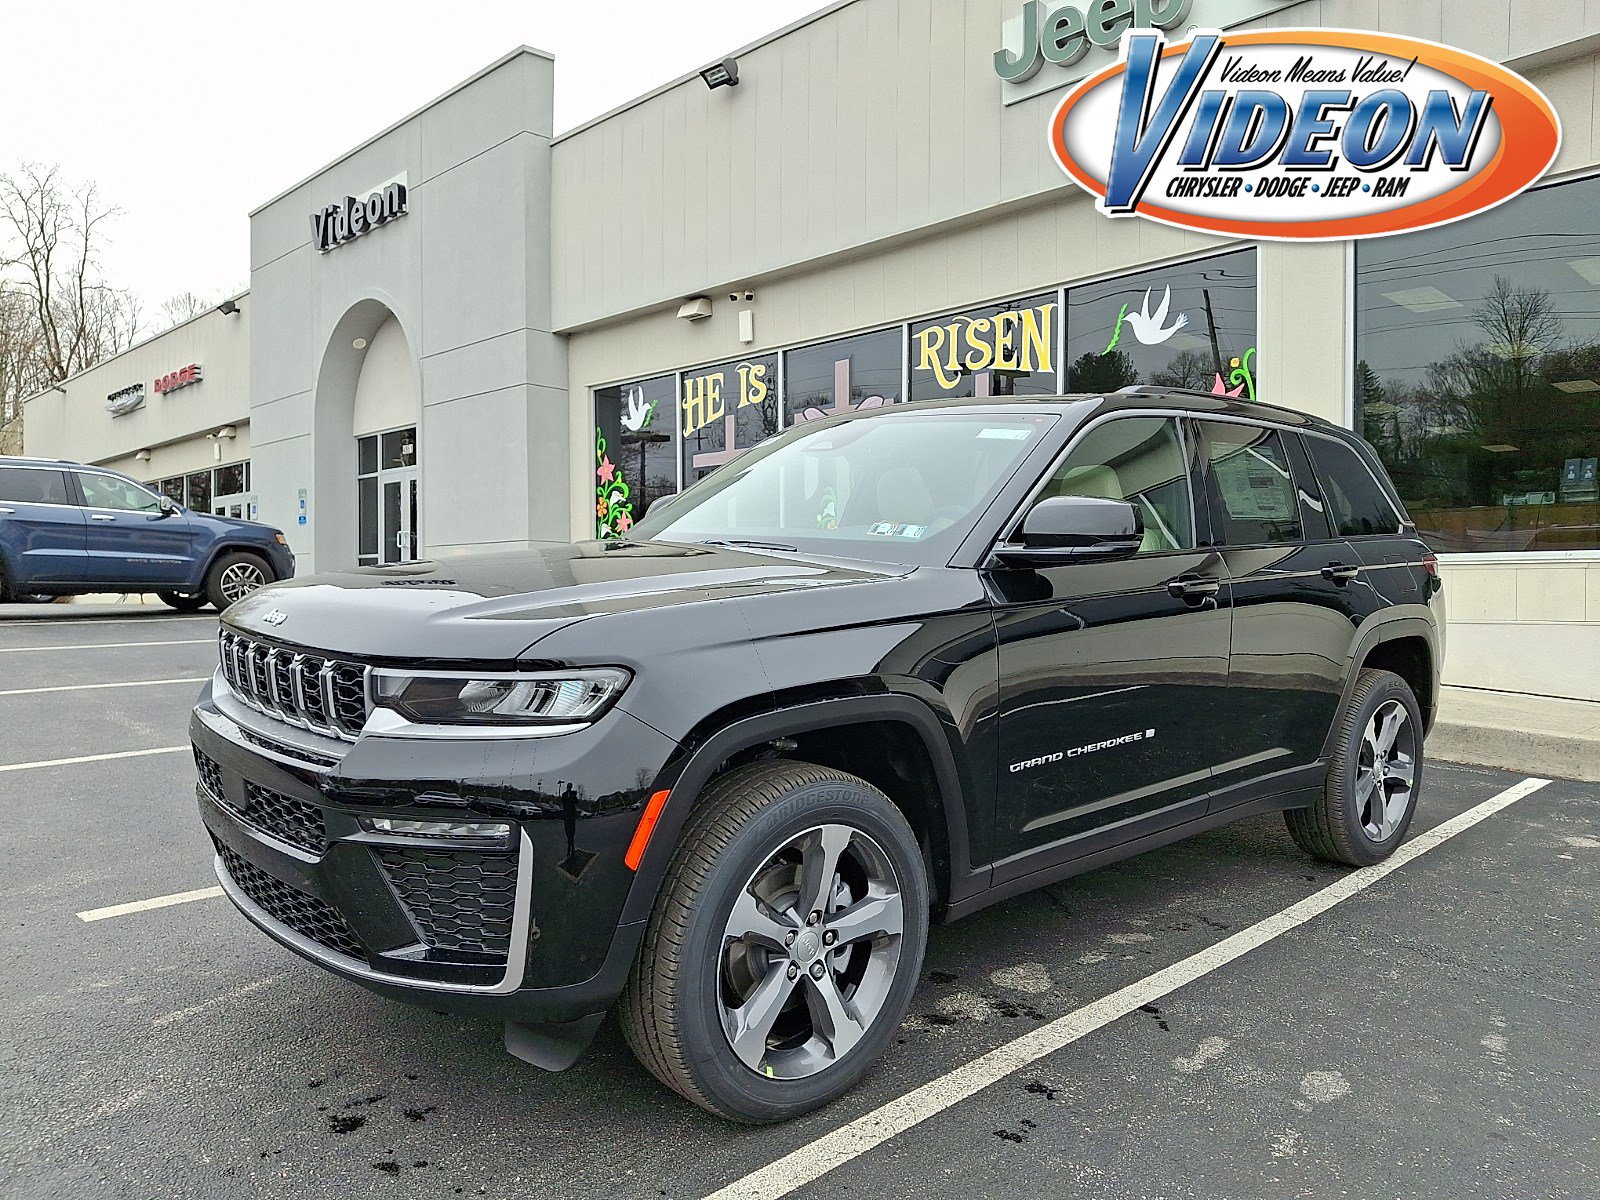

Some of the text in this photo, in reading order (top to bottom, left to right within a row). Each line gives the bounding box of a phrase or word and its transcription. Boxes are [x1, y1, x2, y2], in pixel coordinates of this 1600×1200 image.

[309, 182, 407, 251] Videon
[154, 363, 202, 393] DODGE
[682, 303, 1059, 438] HE IS RISEN
[1009, 731, 1143, 773] GRAND CHEROKEE
